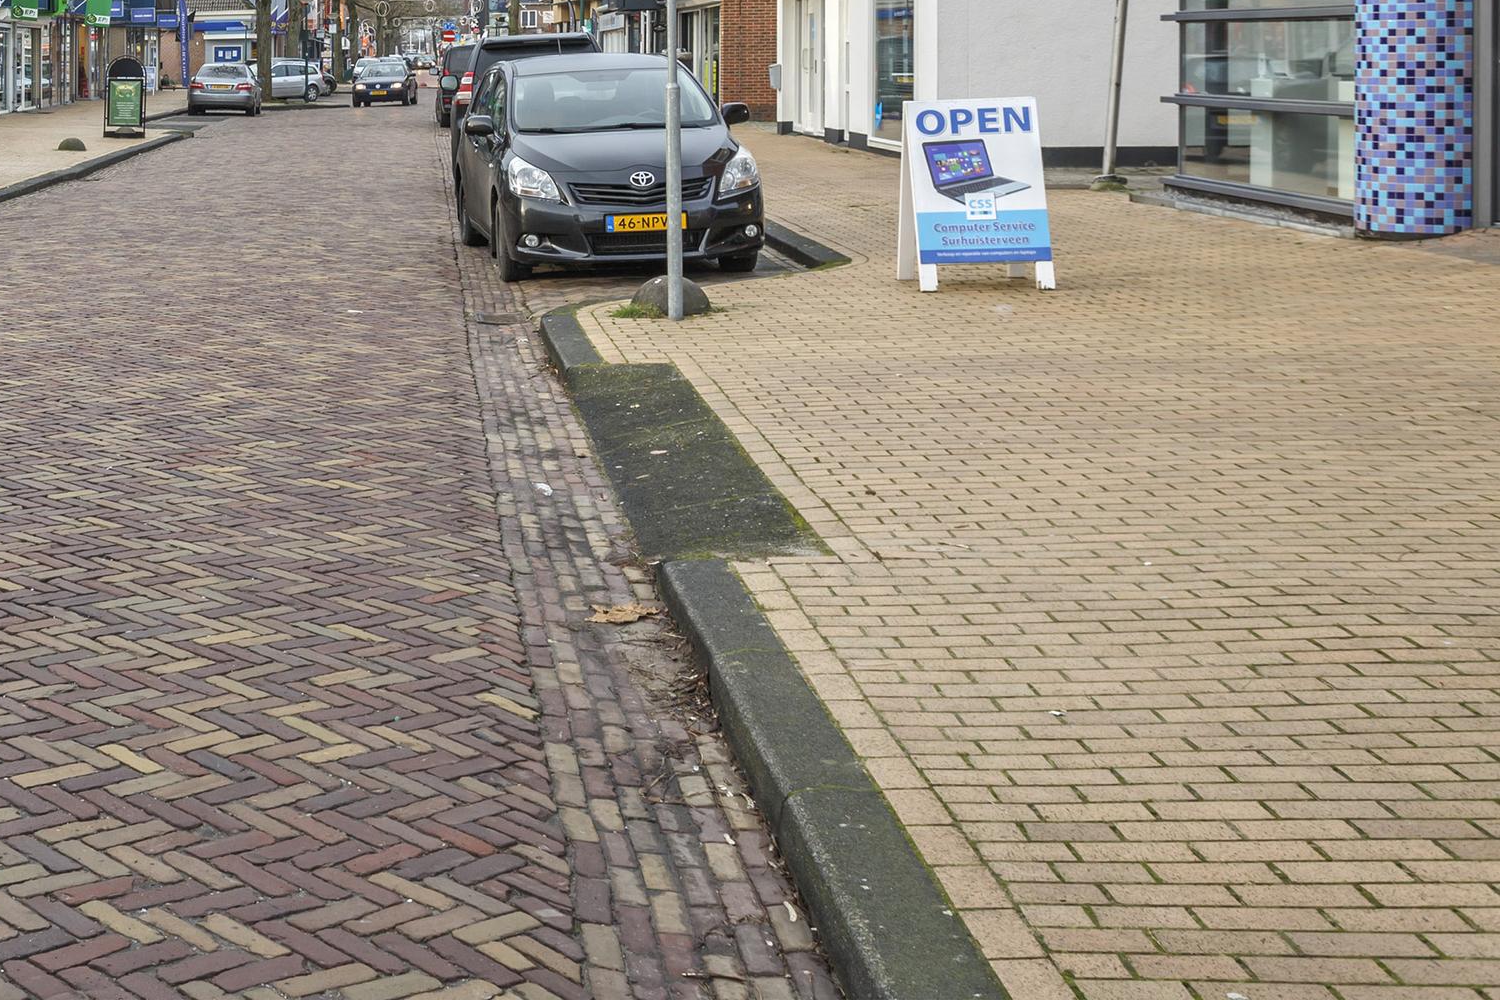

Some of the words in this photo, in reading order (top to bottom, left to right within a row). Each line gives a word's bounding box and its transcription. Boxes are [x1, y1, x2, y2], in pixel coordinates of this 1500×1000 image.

[915, 106, 1032, 135] OPEN
[968, 199, 993, 209] CSS
[618, 216, 668, 229] 46-NPV
[934, 222, 990, 234] Computer
[993, 221, 1036, 231] Service
[941, 236, 1030, 246] Surhuisterveen
